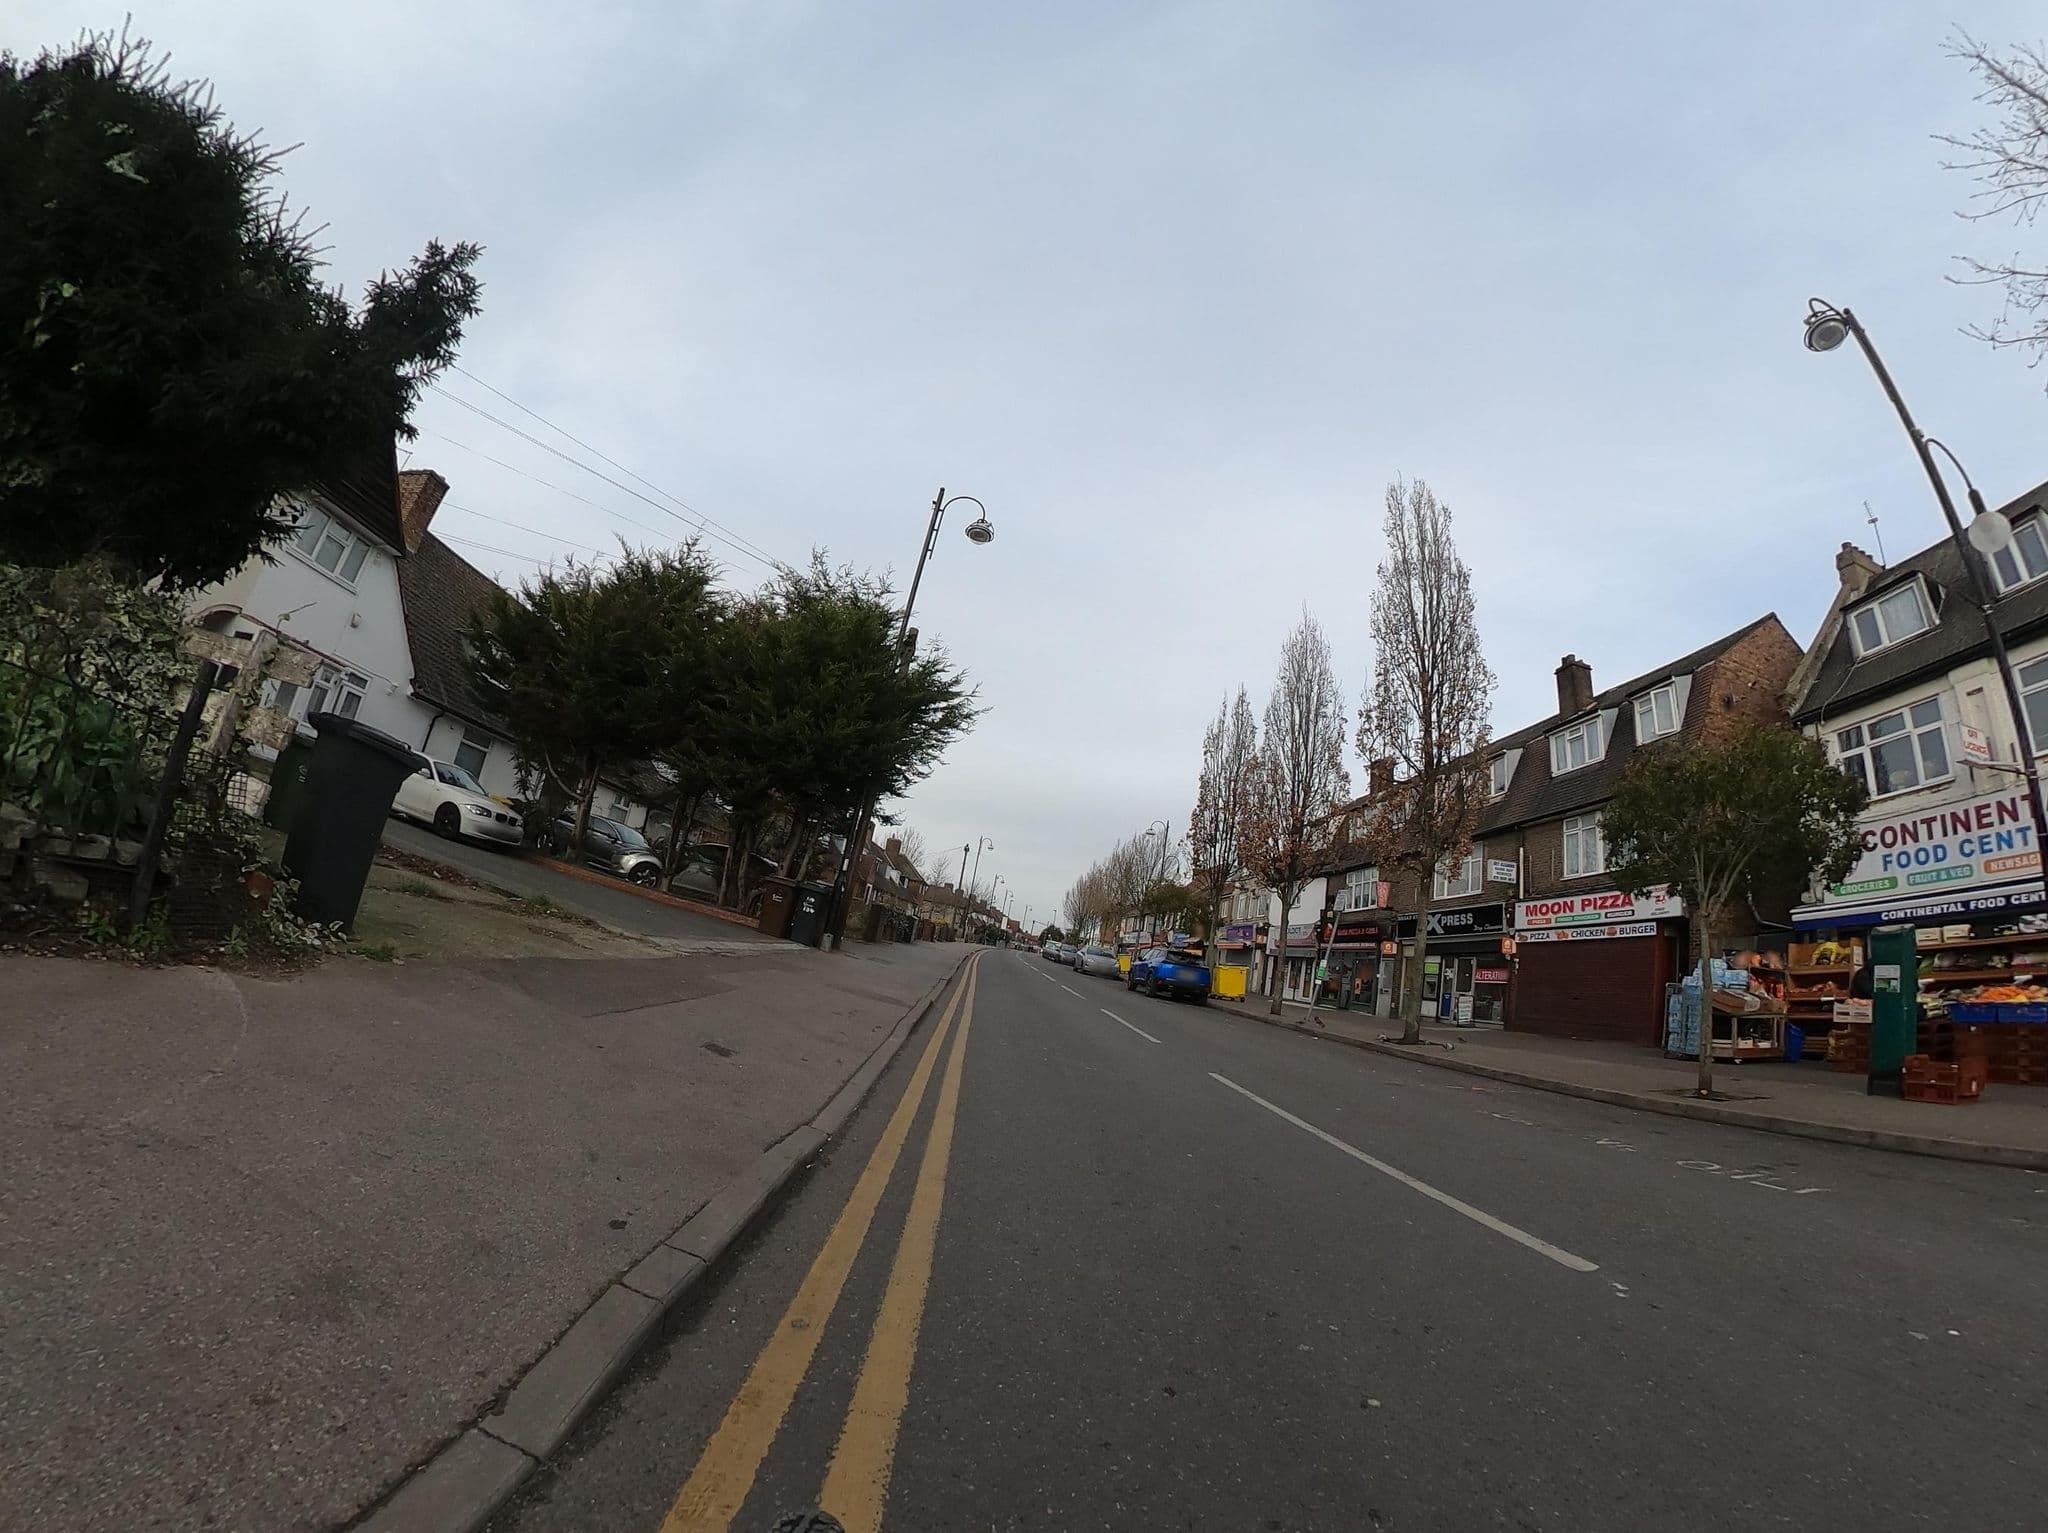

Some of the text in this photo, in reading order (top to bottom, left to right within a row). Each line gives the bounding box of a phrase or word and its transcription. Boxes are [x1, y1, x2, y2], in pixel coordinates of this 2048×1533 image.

[1881, 844, 1948, 871] FOOD
[1840, 866, 1971, 895] GROCERIES FRUIT & VEG
[1525, 900, 1574, 917] MOON
[1581, 894, 1634, 912] PIZZA
[1881, 903, 1965, 921] CONTINENTAL
[1969, 896, 2006, 910] FOOD
[1530, 924, 1656, 940] PIZZA CHICKEN BURGER
